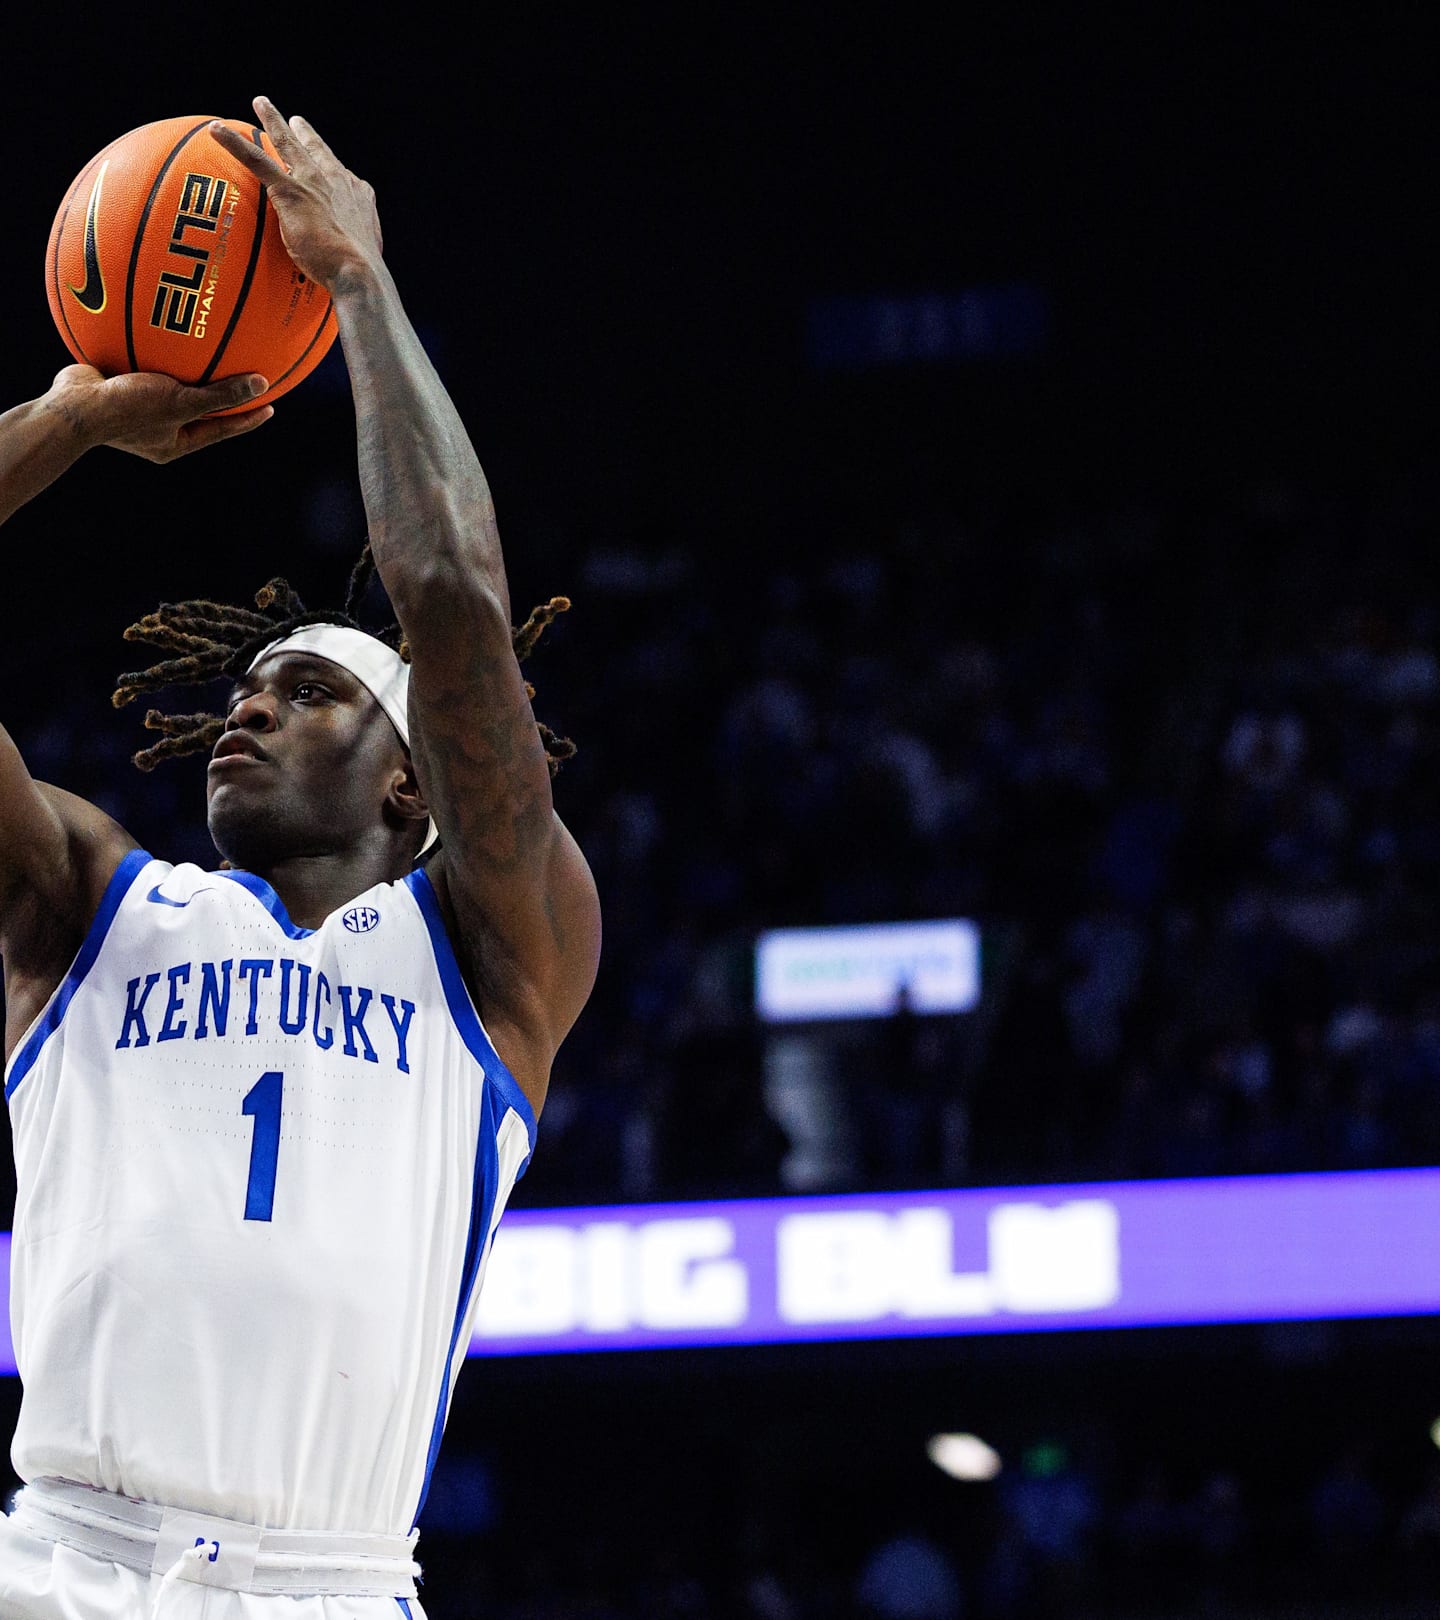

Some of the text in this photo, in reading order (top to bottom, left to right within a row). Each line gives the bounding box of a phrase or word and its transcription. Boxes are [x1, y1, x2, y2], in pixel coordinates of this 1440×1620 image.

[150, 172, 229, 336] ELITE
[343, 907, 379, 933] SEC
[115, 958, 416, 1075] KENTUCKY
[242, 1071, 284, 1222] 1
[474, 1216, 749, 1338] BIG
